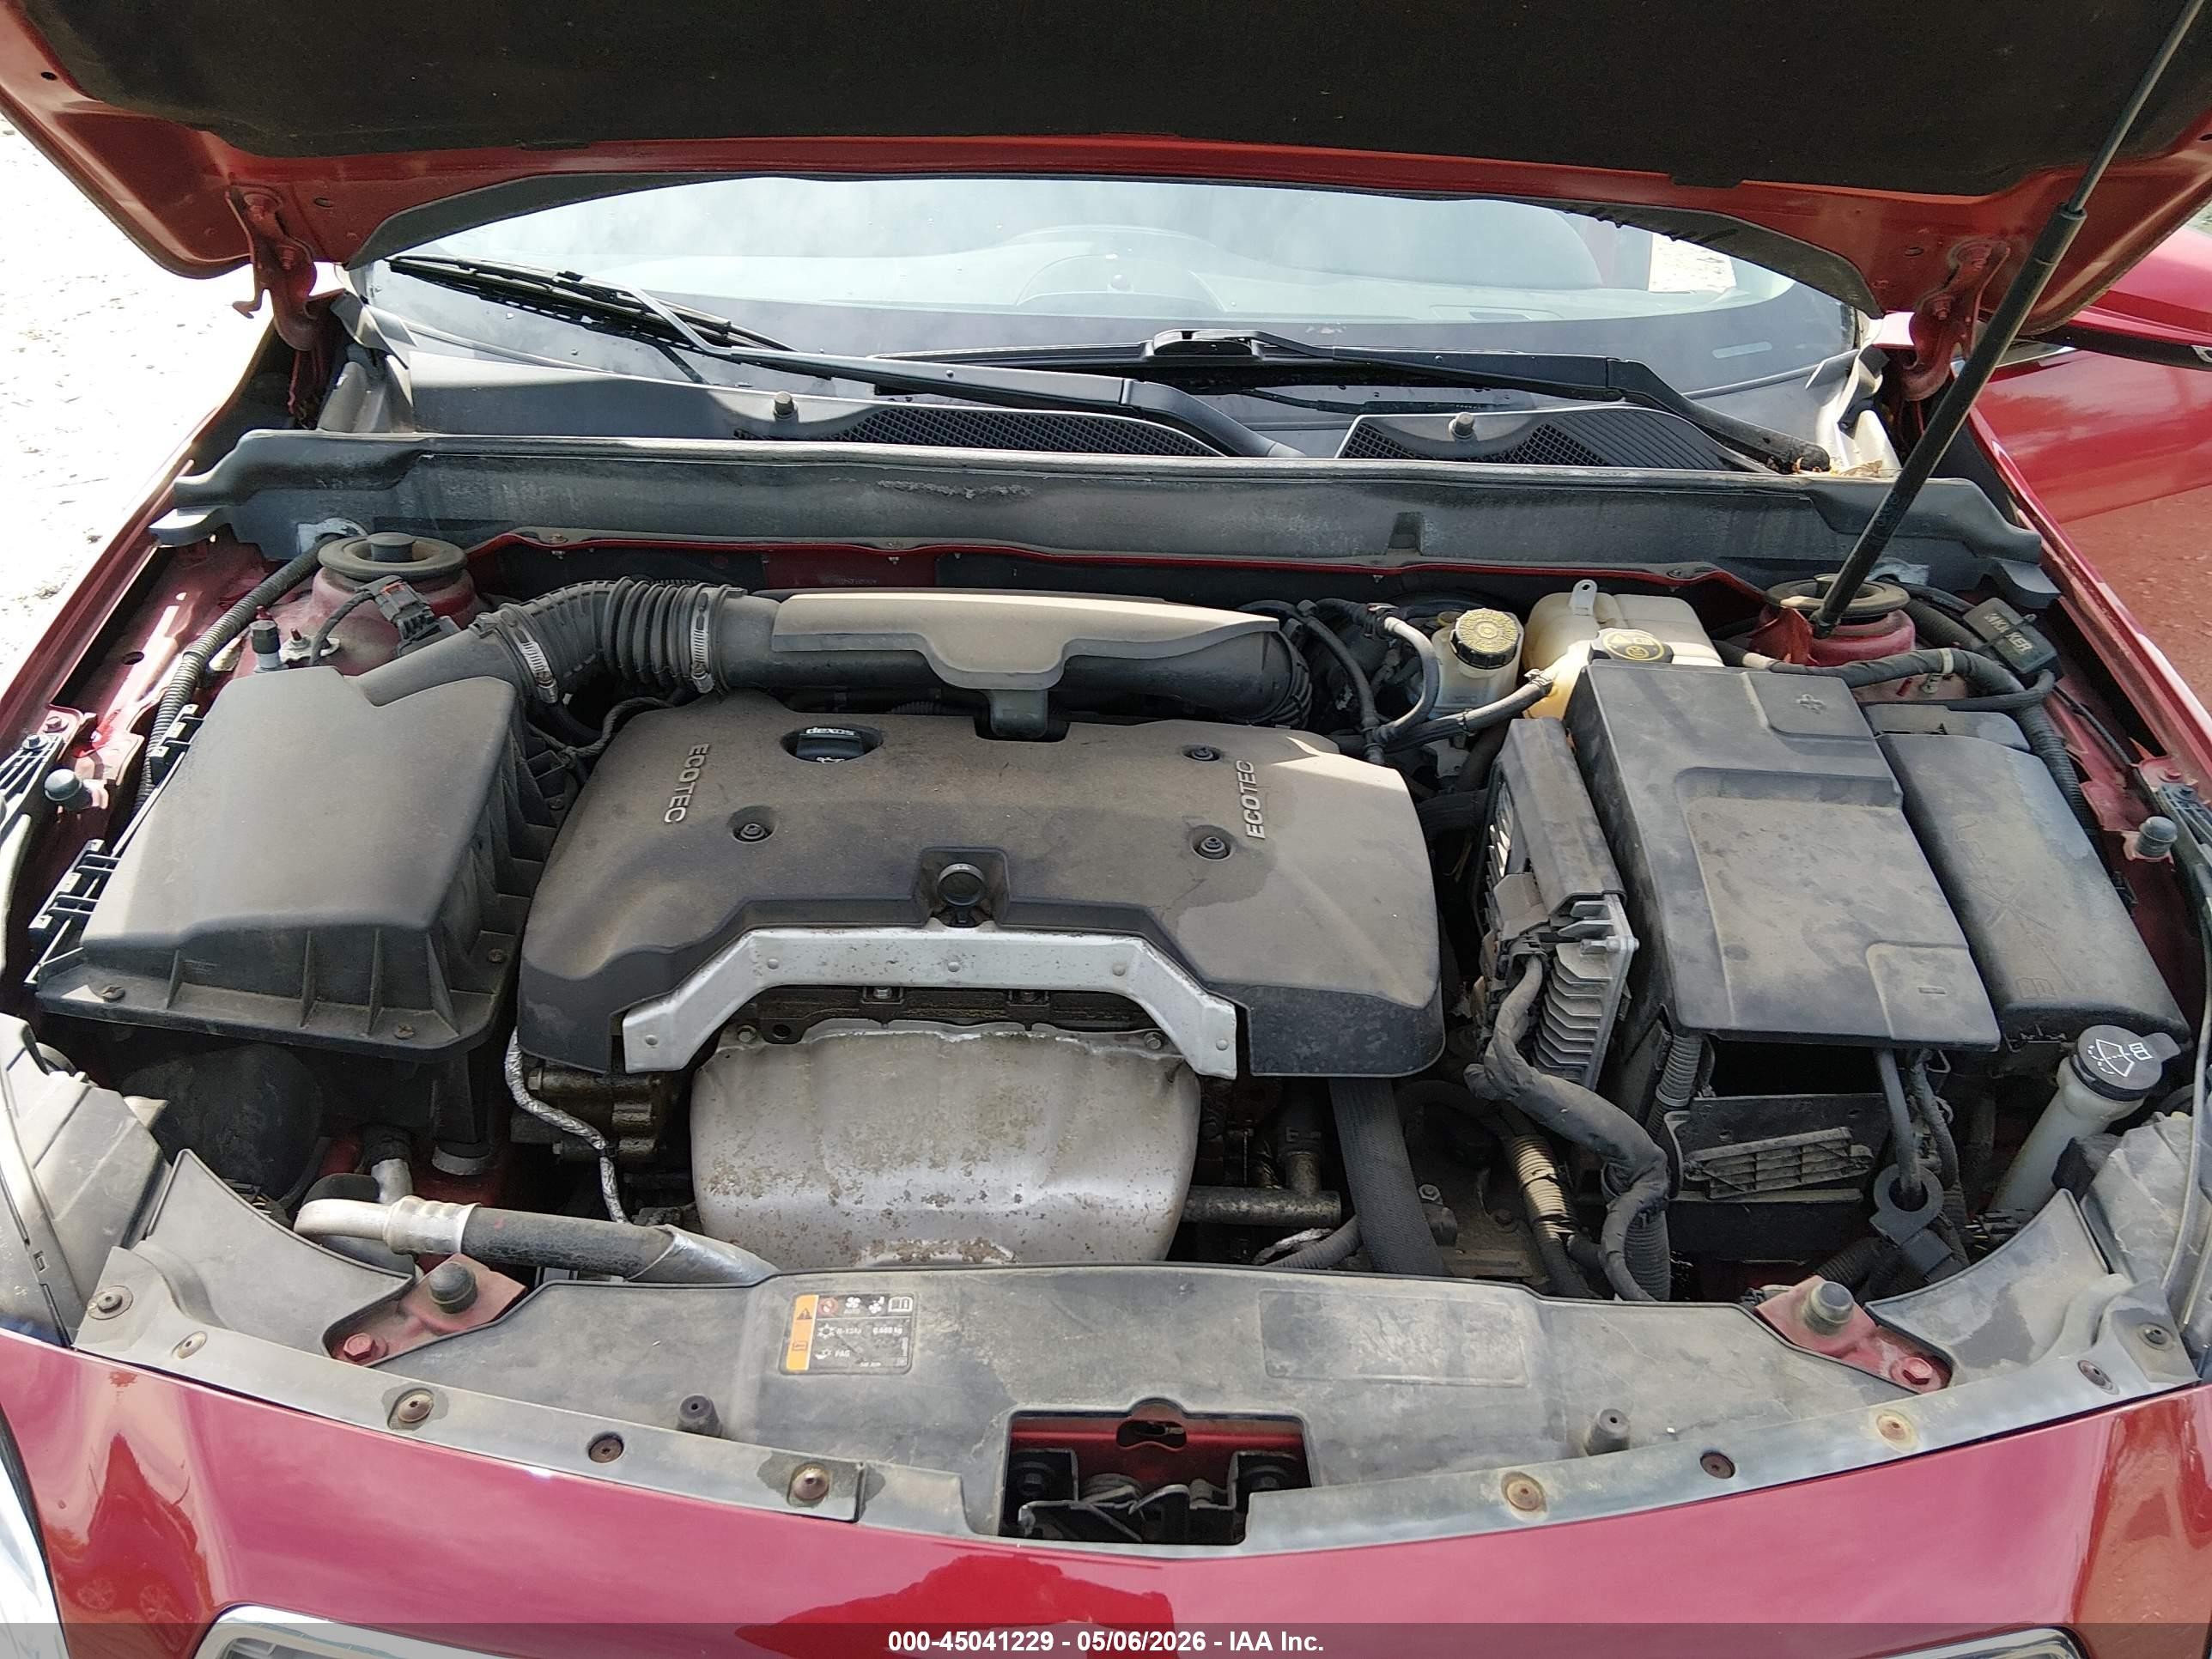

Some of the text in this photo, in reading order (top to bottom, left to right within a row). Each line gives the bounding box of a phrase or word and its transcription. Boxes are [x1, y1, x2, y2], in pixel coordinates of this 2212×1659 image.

[805, 727, 856, 736] dexos
[665, 744, 709, 823] ECOTEC
[1237, 760, 1266, 839] ECOTEC
